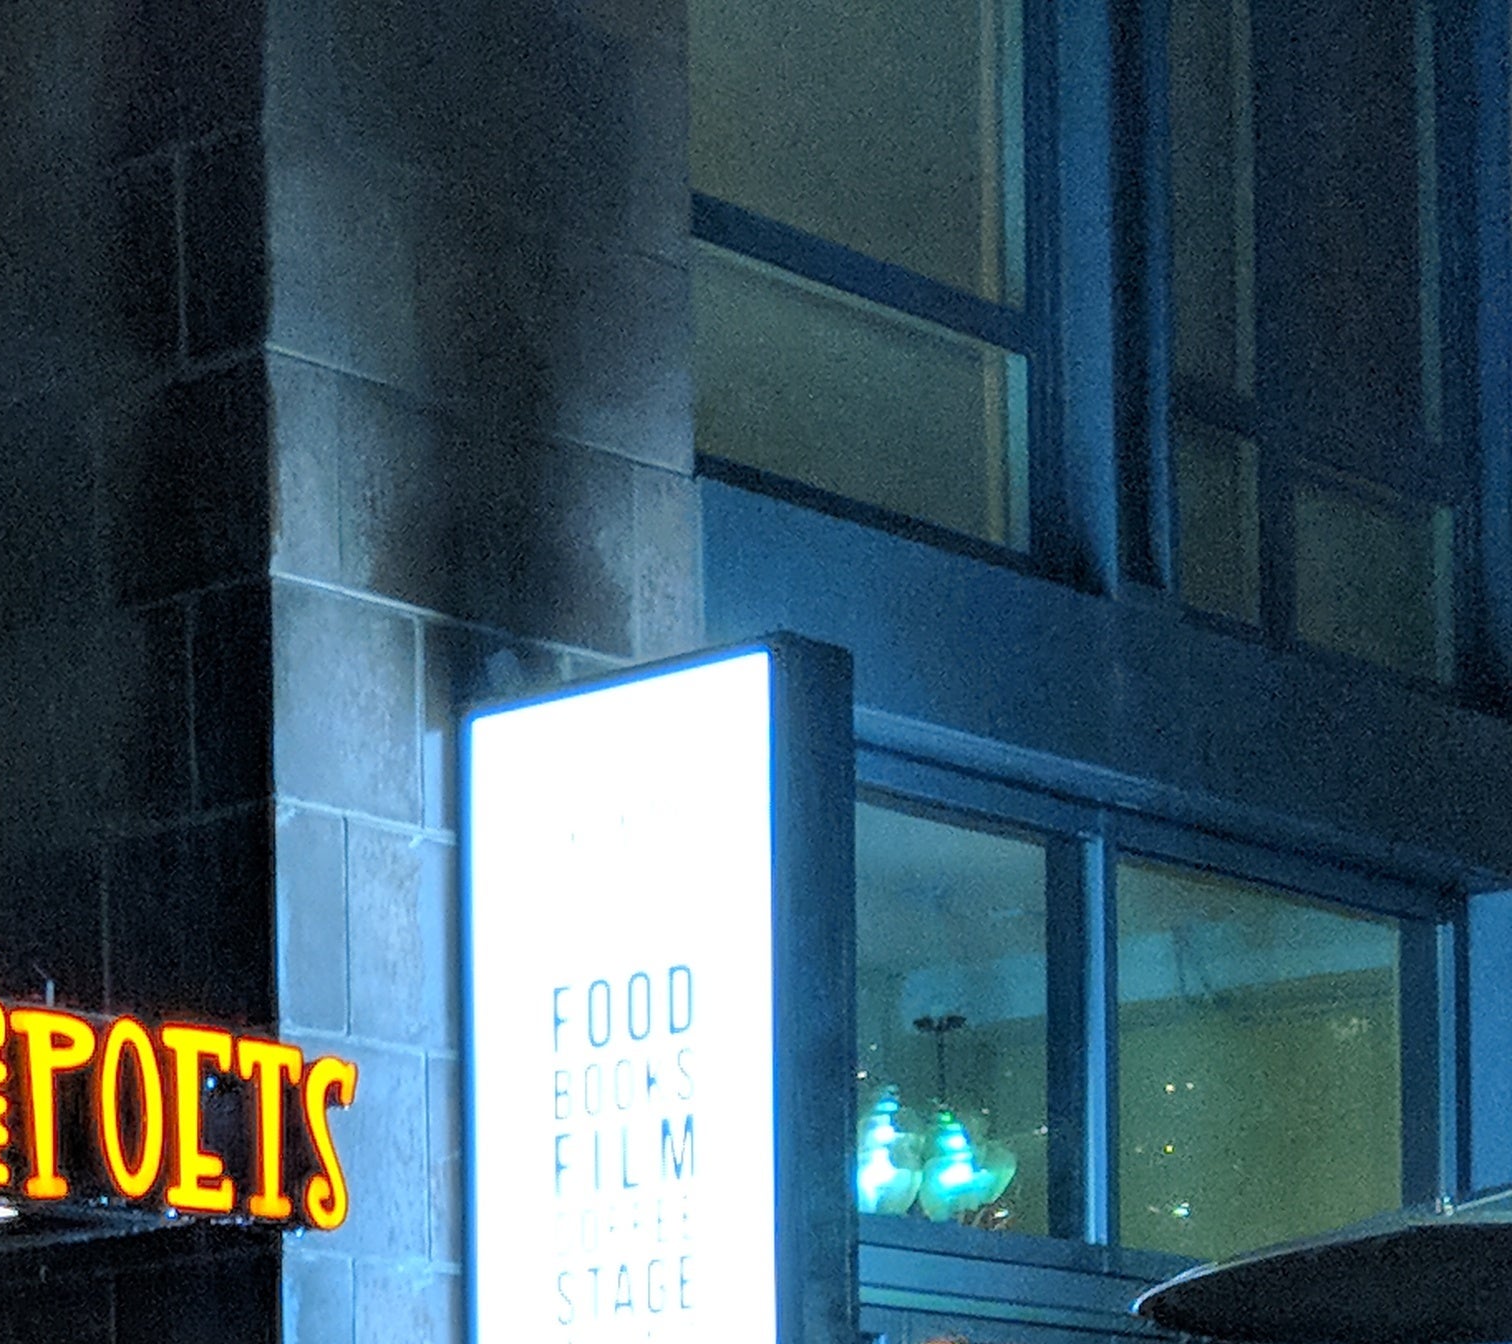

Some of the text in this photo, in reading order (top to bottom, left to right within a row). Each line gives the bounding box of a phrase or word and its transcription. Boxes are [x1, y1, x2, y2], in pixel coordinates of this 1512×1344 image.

[551, 962, 696, 1054] FOOD
[11, 1008, 358, 1231] POETS
[552, 1046, 696, 1120] BOOKS
[551, 1112, 696, 1199] FILM
[555, 1253, 695, 1327] STAGE
